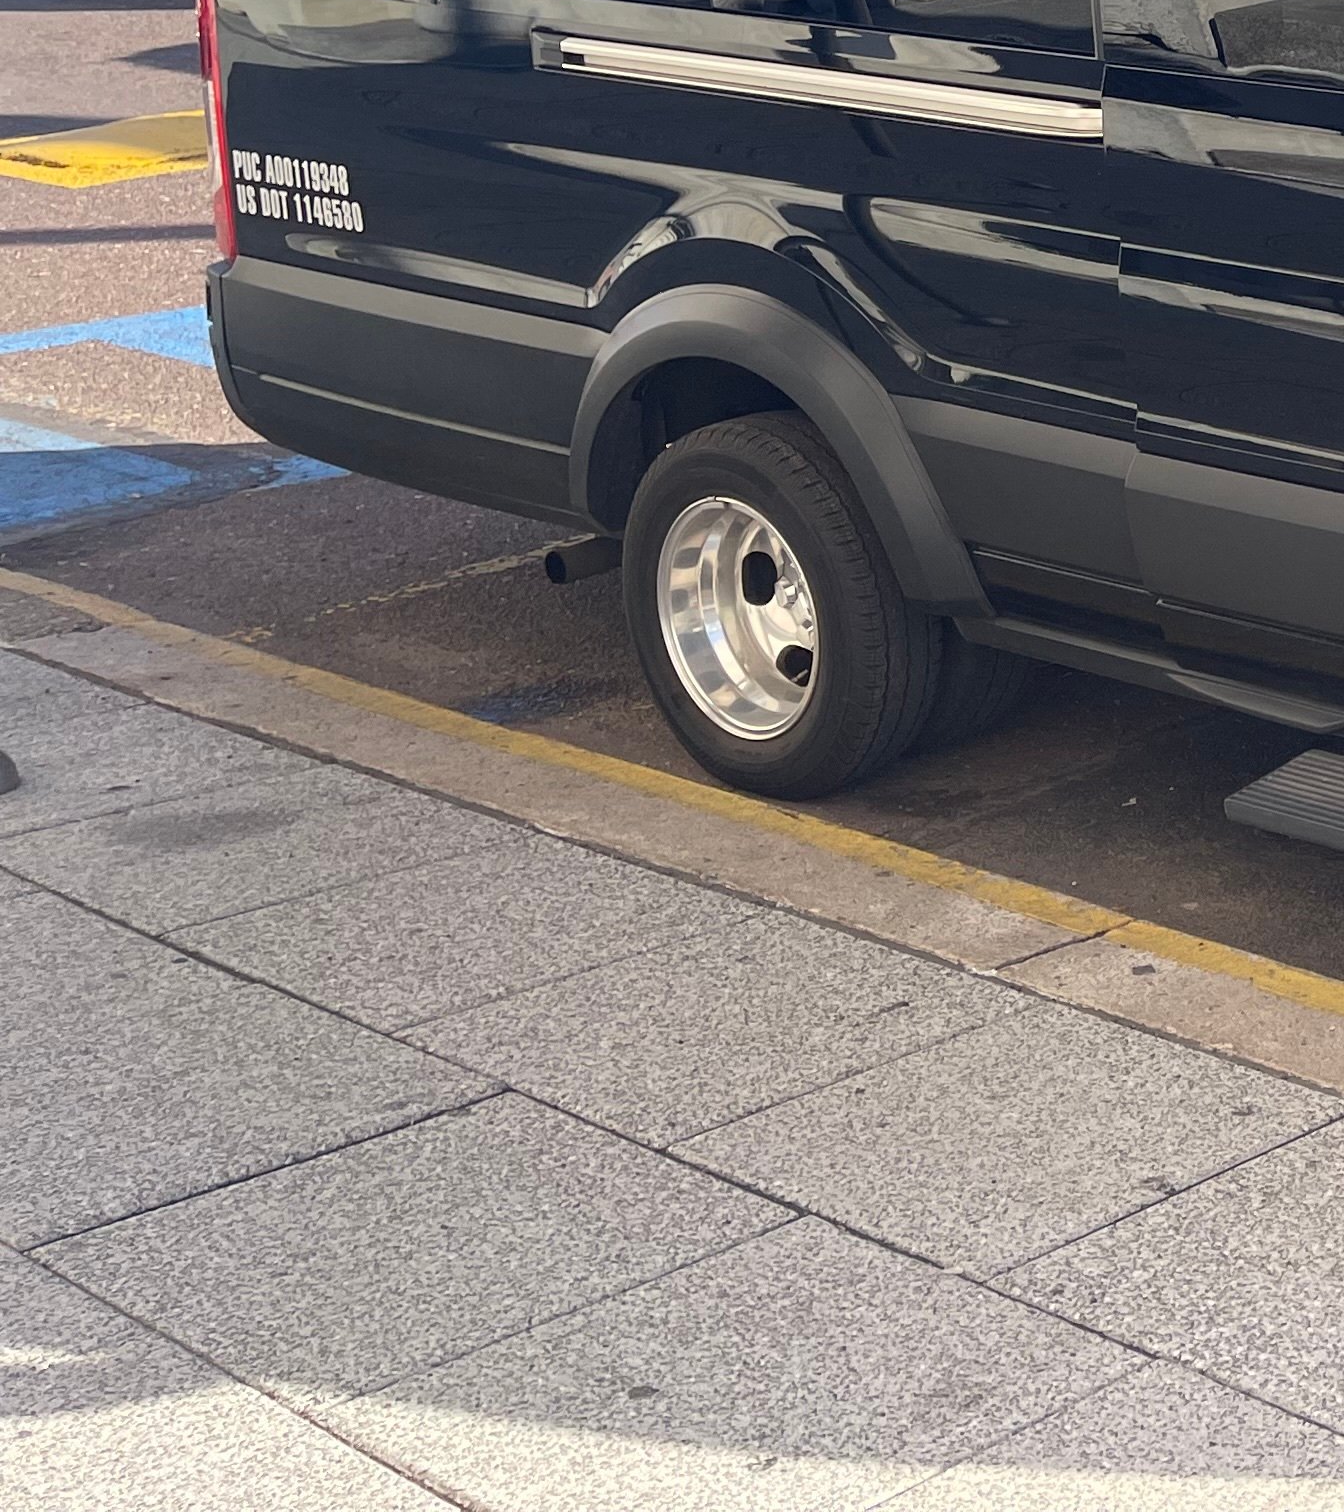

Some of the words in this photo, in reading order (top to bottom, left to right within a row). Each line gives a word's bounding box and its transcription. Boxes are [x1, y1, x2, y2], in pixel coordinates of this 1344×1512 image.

[232, 149, 261, 182] PUC
[265, 154, 349, 196] A00119348
[236, 183, 257, 215] US
[260, 187, 288, 220] DOT
[293, 193, 364, 233] 1146580
